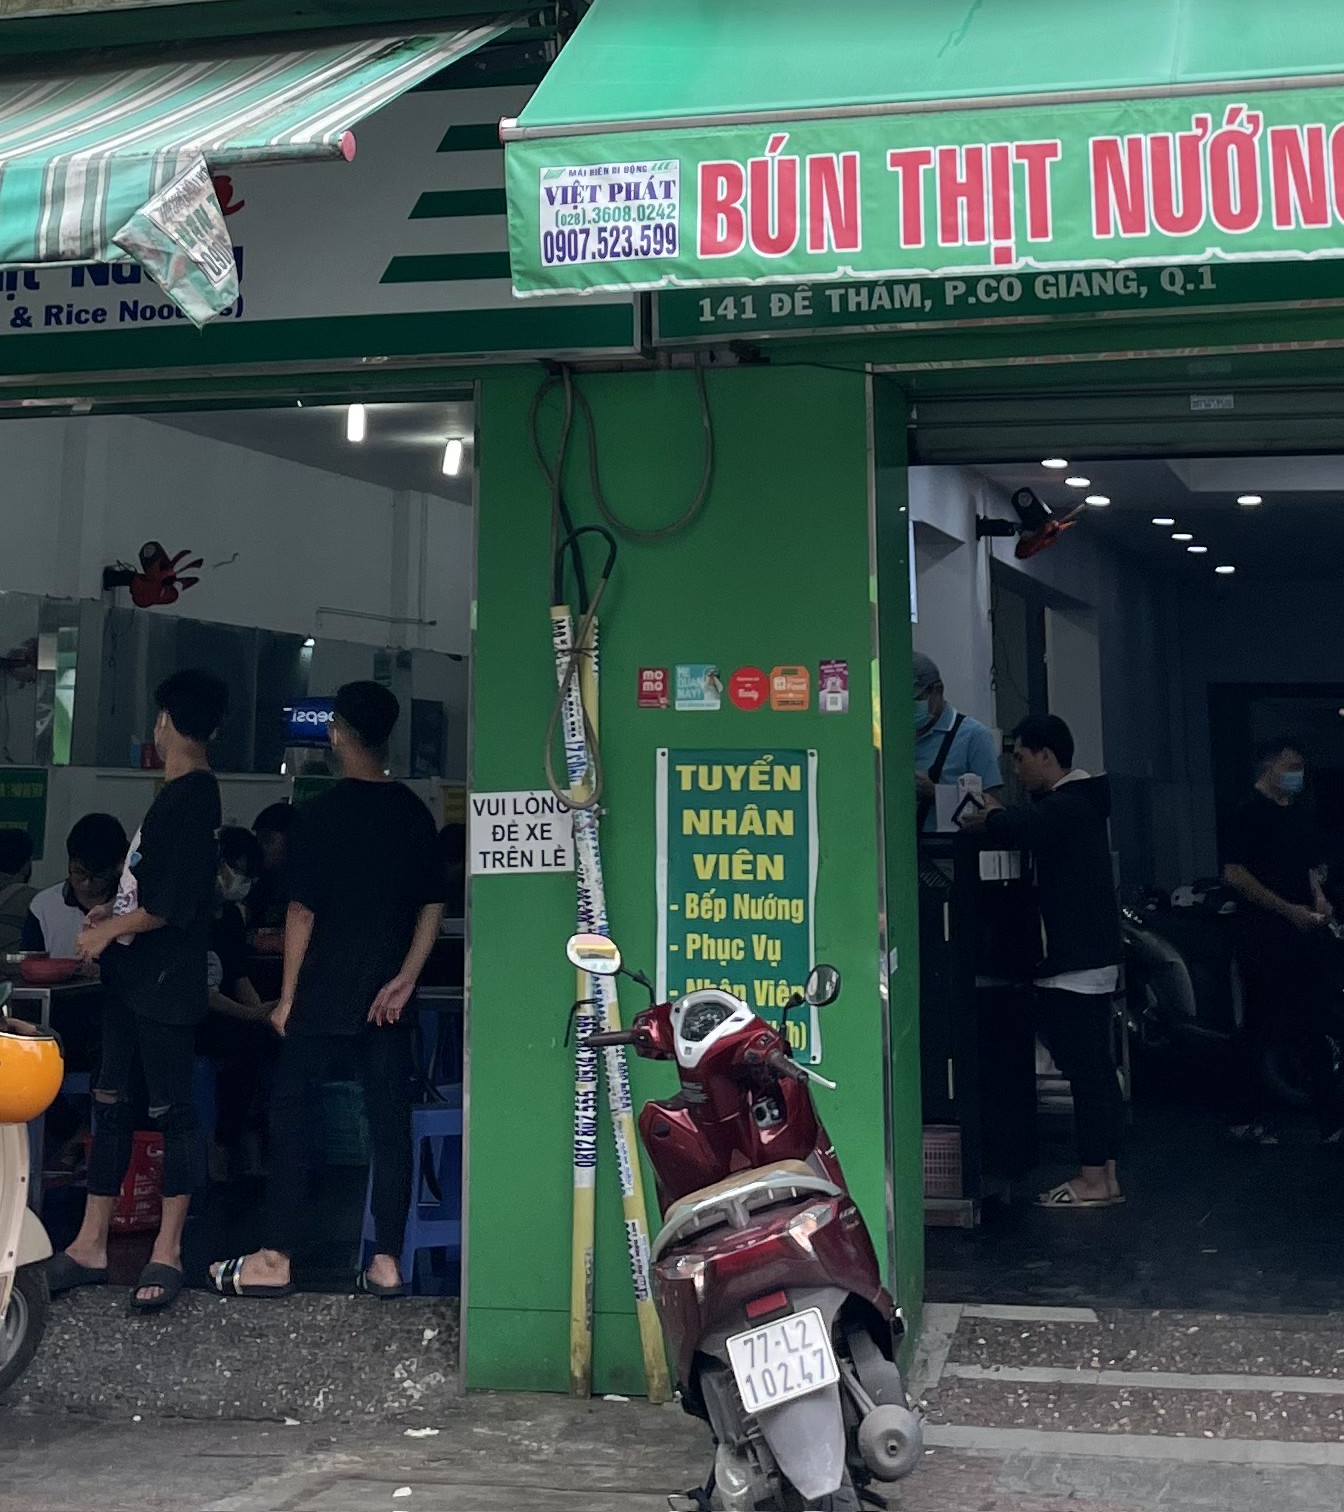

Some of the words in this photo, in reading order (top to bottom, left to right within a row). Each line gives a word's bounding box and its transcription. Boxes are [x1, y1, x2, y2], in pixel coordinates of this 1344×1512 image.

[544, 179, 602, 210] VIỆT
[608, 175, 676, 203] PHÁT
[696, 132, 860, 260] BÚN
[887, 139, 1060, 266] THỊT
[555, 202, 676, 228] (028).3608.0242
[543, 222, 677, 264] 0907.523.599
[698, 295, 757, 322] 141
[825, 279, 933, 313] THÁM,
[1034, 269, 1148, 300] GIANG,
[1160, 265, 1216, 296] Q.1
[9, 305, 32, 329] &
[43, 301, 107, 326] Rice
[675, 754, 801, 792] TUYỂN
[472, 797, 506, 818] VUI
[682, 803, 794, 836] NHÂN
[524, 823, 553, 842] XE
[478, 845, 534, 869] TRÊN
[693, 848, 785, 881] VIÊN
[685, 889, 729, 924] Bếp
[733, 889, 804, 925] Nướng
[685, 934, 745, 967] Phục
[752, 934, 782, 968] Vụ
[746, 1349, 825, 1404] 102.47
